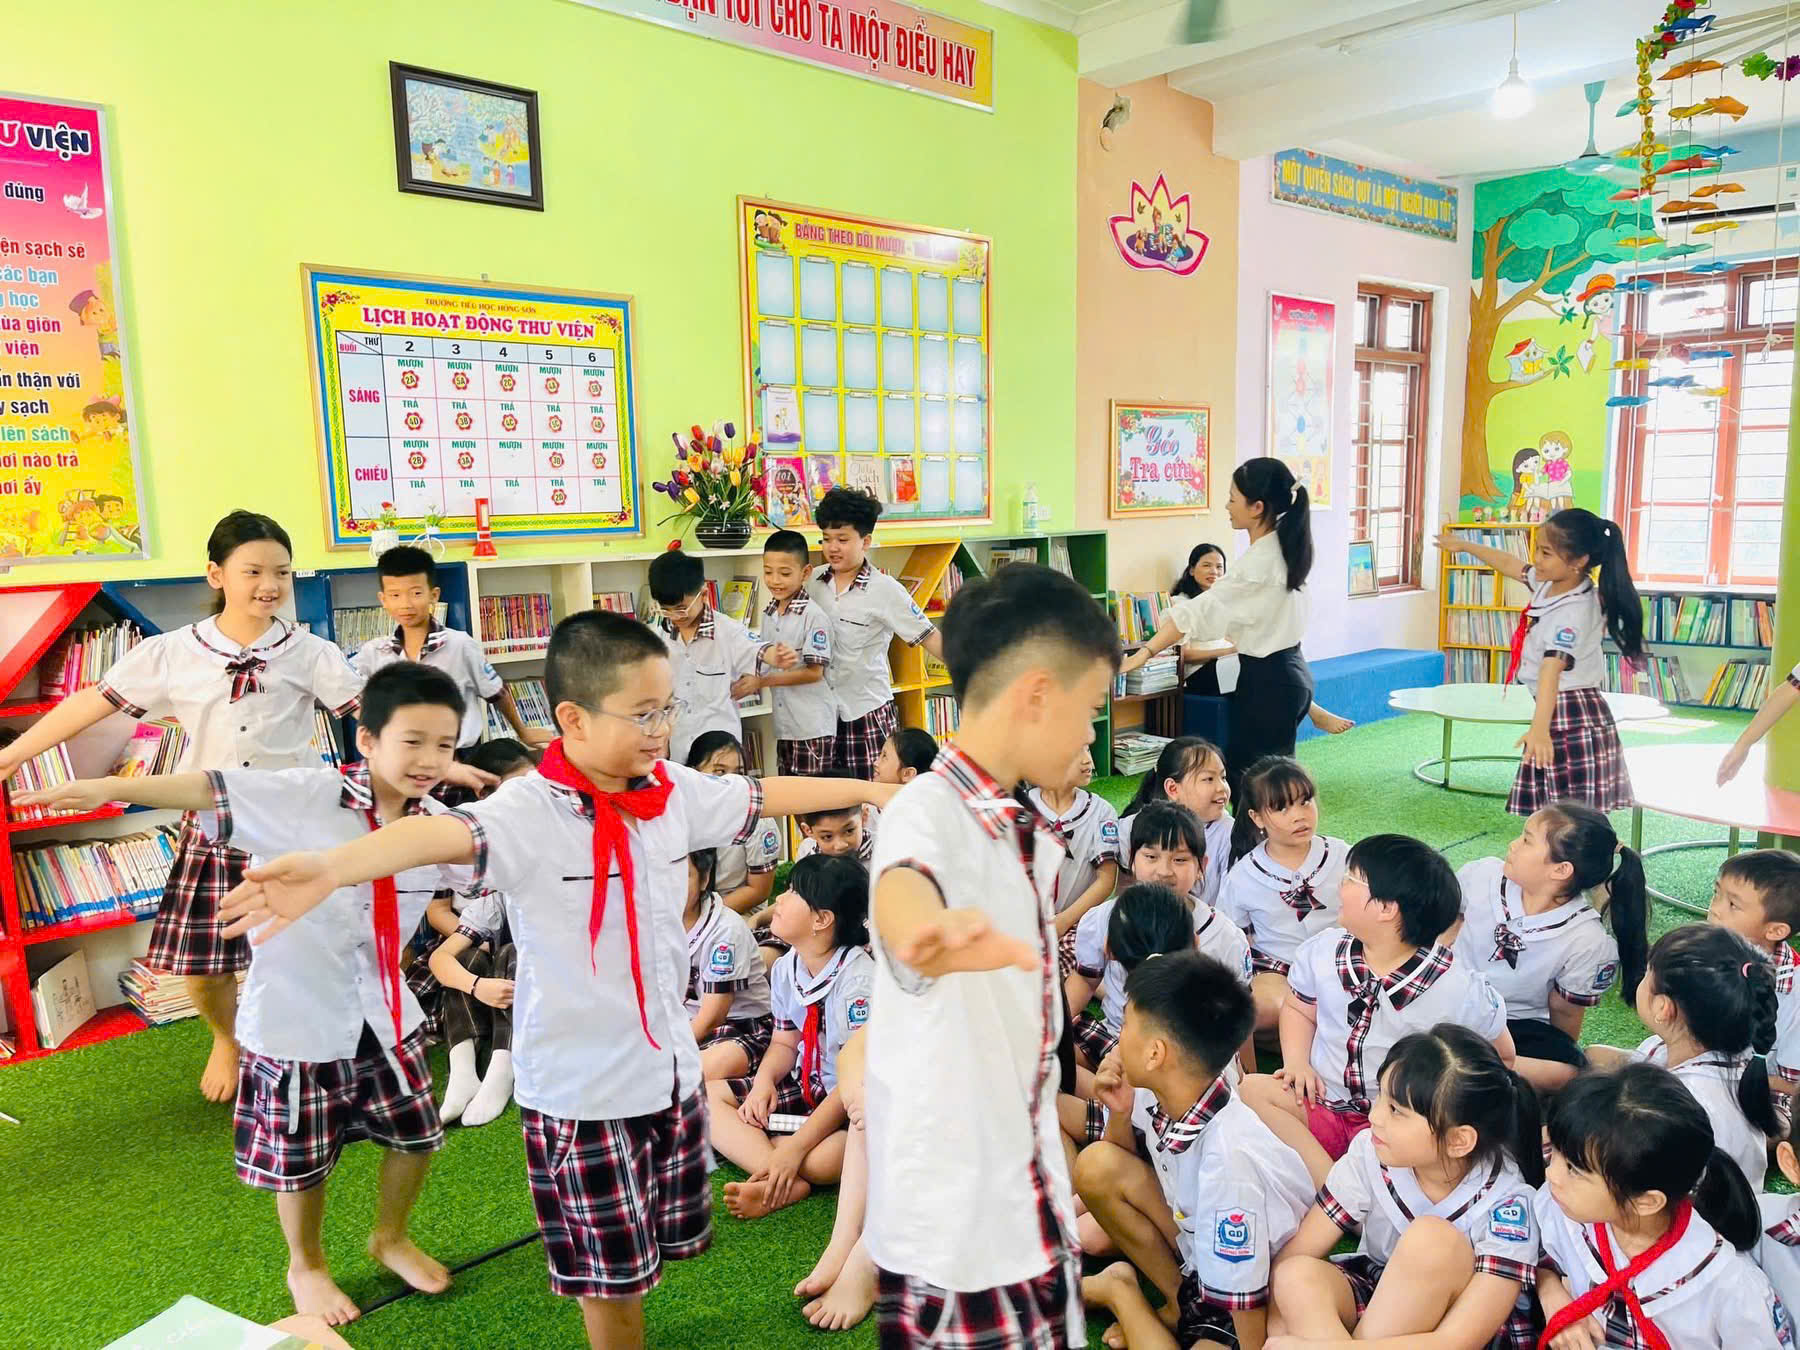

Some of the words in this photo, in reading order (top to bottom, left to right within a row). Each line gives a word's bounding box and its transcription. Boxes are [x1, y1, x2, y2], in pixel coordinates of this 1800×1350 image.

[818, 3, 844, 51] TA
[850, 9, 890, 71] MỘT
[896, 18, 936, 77] ĐIỀU
[943, 41, 976, 88] HAY
[26, 124, 89, 158] VIỆN
[795, 218, 824, 240] BẢNG
[828, 228, 854, 245] THEO
[25, 241, 62, 258] sạch
[68, 243, 85, 258] sẽ
[28, 267, 57, 286] bạn
[9, 291, 38, 309] học
[363, 308, 406, 327] LỊCH
[411, 312, 460, 331] HOẠT
[465, 312, 513, 334] ĐỘNG
[518, 320, 552, 335] THƯ
[557, 320, 594, 341] VIỆN
[5, 340, 39, 358] viện
[364, 335, 379, 347] THỨ
[405, 341, 414, 352] 2
[452, 344, 460, 354] 3
[500, 347, 508, 357] 4
[545, 350, 553, 360] 5
[588, 352, 597, 362] 6
[17, 372, 51, 390] thận
[57, 373, 80, 388] với
[405, 376, 416, 385] 2A
[349, 387, 380, 403] SÁNG
[11, 399, 48, 416] sạch
[32, 426, 69, 441] sách
[23, 453, 51, 467] nào
[57, 450, 78, 467] trả
[355, 465, 388, 481] CHIỀU
[1130, 457, 1160, 482] Tra
[1164, 456, 1193, 482] cứu
[24, 476, 41, 495] ấy
[1228, 1229, 1243, 1238] GD
